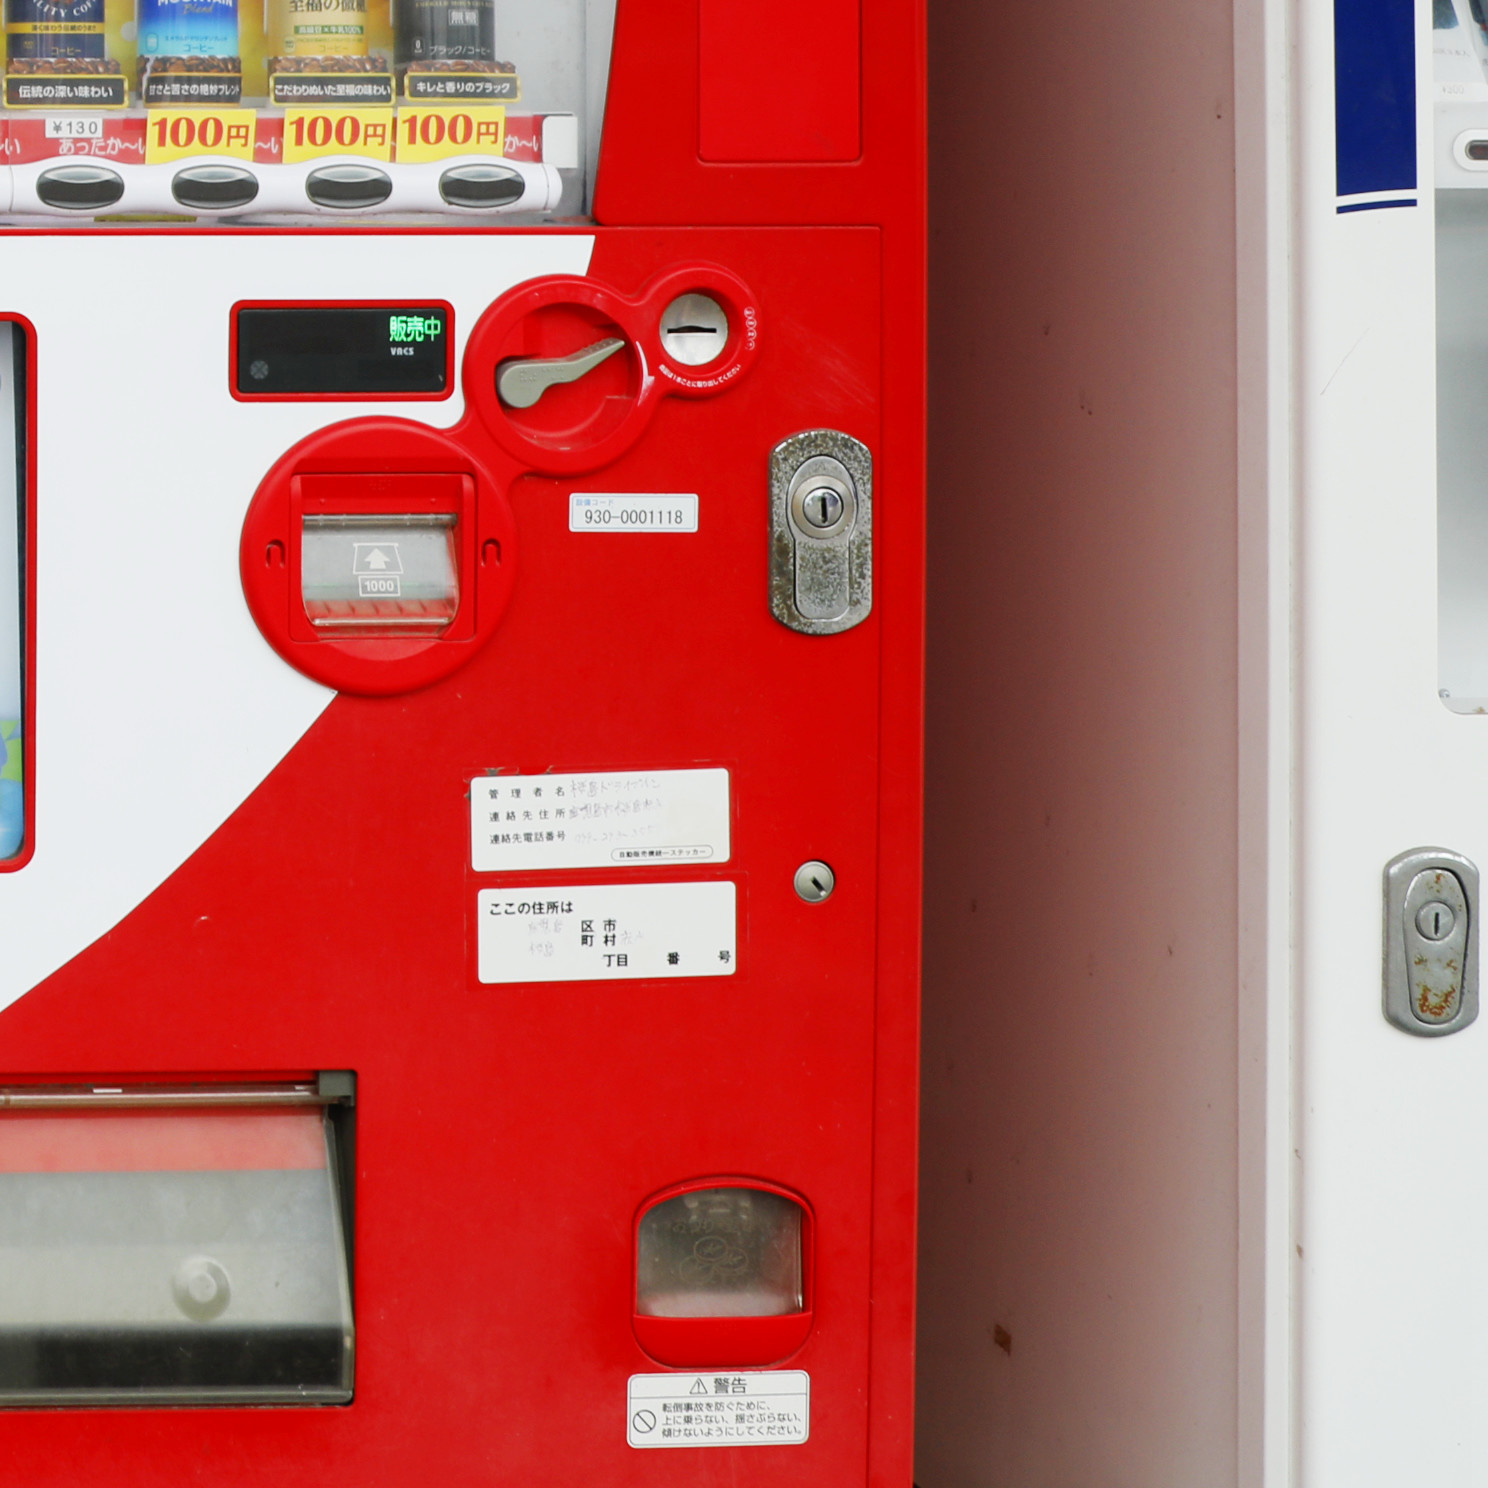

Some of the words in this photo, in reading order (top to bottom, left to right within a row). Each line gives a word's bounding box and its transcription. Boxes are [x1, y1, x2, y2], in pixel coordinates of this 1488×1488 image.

[17, 84, 114, 98] 伝統の深い味わい
[274, 83, 392, 97] こだわりぬいた至福の味わい
[416, 80, 510, 93] キレと香りのブラック
[151, 116, 250, 149] 100円
[288, 115, 388, 148] 100円
[401, 113, 500, 147] 100円
[389, 315, 442, 342] 販売中
[584, 509, 684, 525] 930-0001118
[363, 578, 395, 593] 1000
[488, 785, 566, 800] 管理者名
[488, 808, 566, 823] 連絡先住所
[489, 830, 566, 844] 連絡先電話番号
[619, 848, 706, 859] 自動販売機統一ステッカー
[489, 901, 574, 916] ここの住所は
[581, 919, 594, 933] 区
[603, 918, 617, 932] 市
[581, 934, 594, 947] 町
[603, 933, 616, 947] 村
[603, 954, 629, 967] 丁目
[667, 952, 680, 965] 番
[718, 950, 731, 964] 号
[713, 1376, 748, 1394] 警告
[662, 1402, 772, 1413] 転倒事故を防ぐために、
[662, 1413, 802, 1425] 上に乗らない、揺さぶらない、
[662, 1425, 803, 1439] 傾けないようにしてください。
